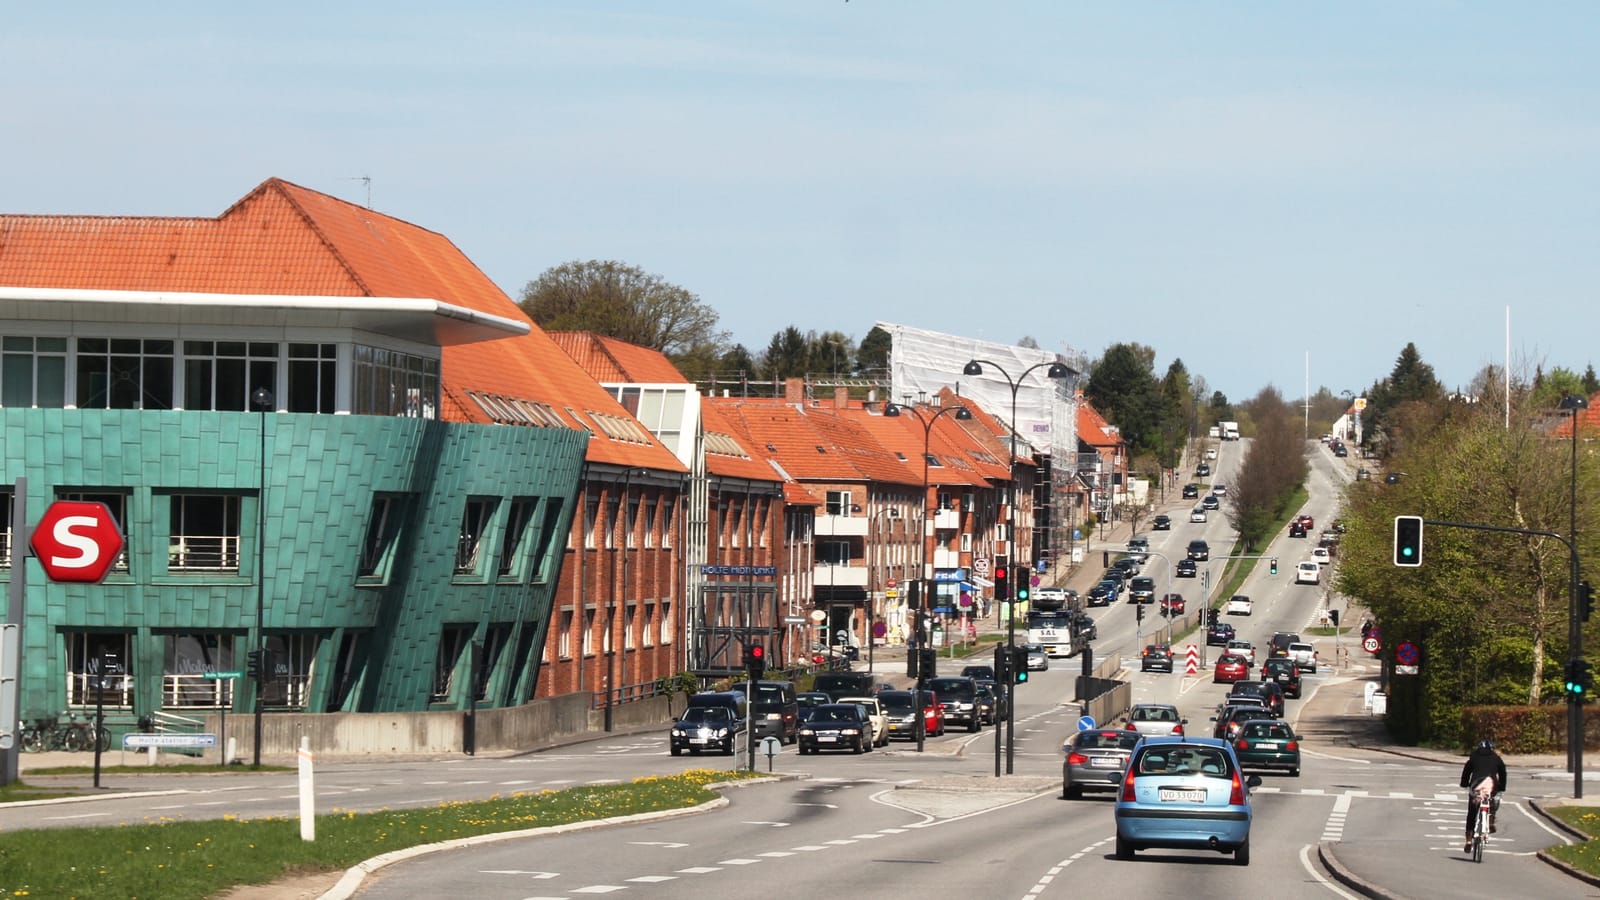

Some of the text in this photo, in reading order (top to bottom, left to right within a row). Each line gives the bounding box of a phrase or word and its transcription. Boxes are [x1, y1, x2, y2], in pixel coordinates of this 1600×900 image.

[50, 515, 101, 569] S
[701, 566, 729, 574] HOLTE
[1366, 641, 1377, 649] 70
